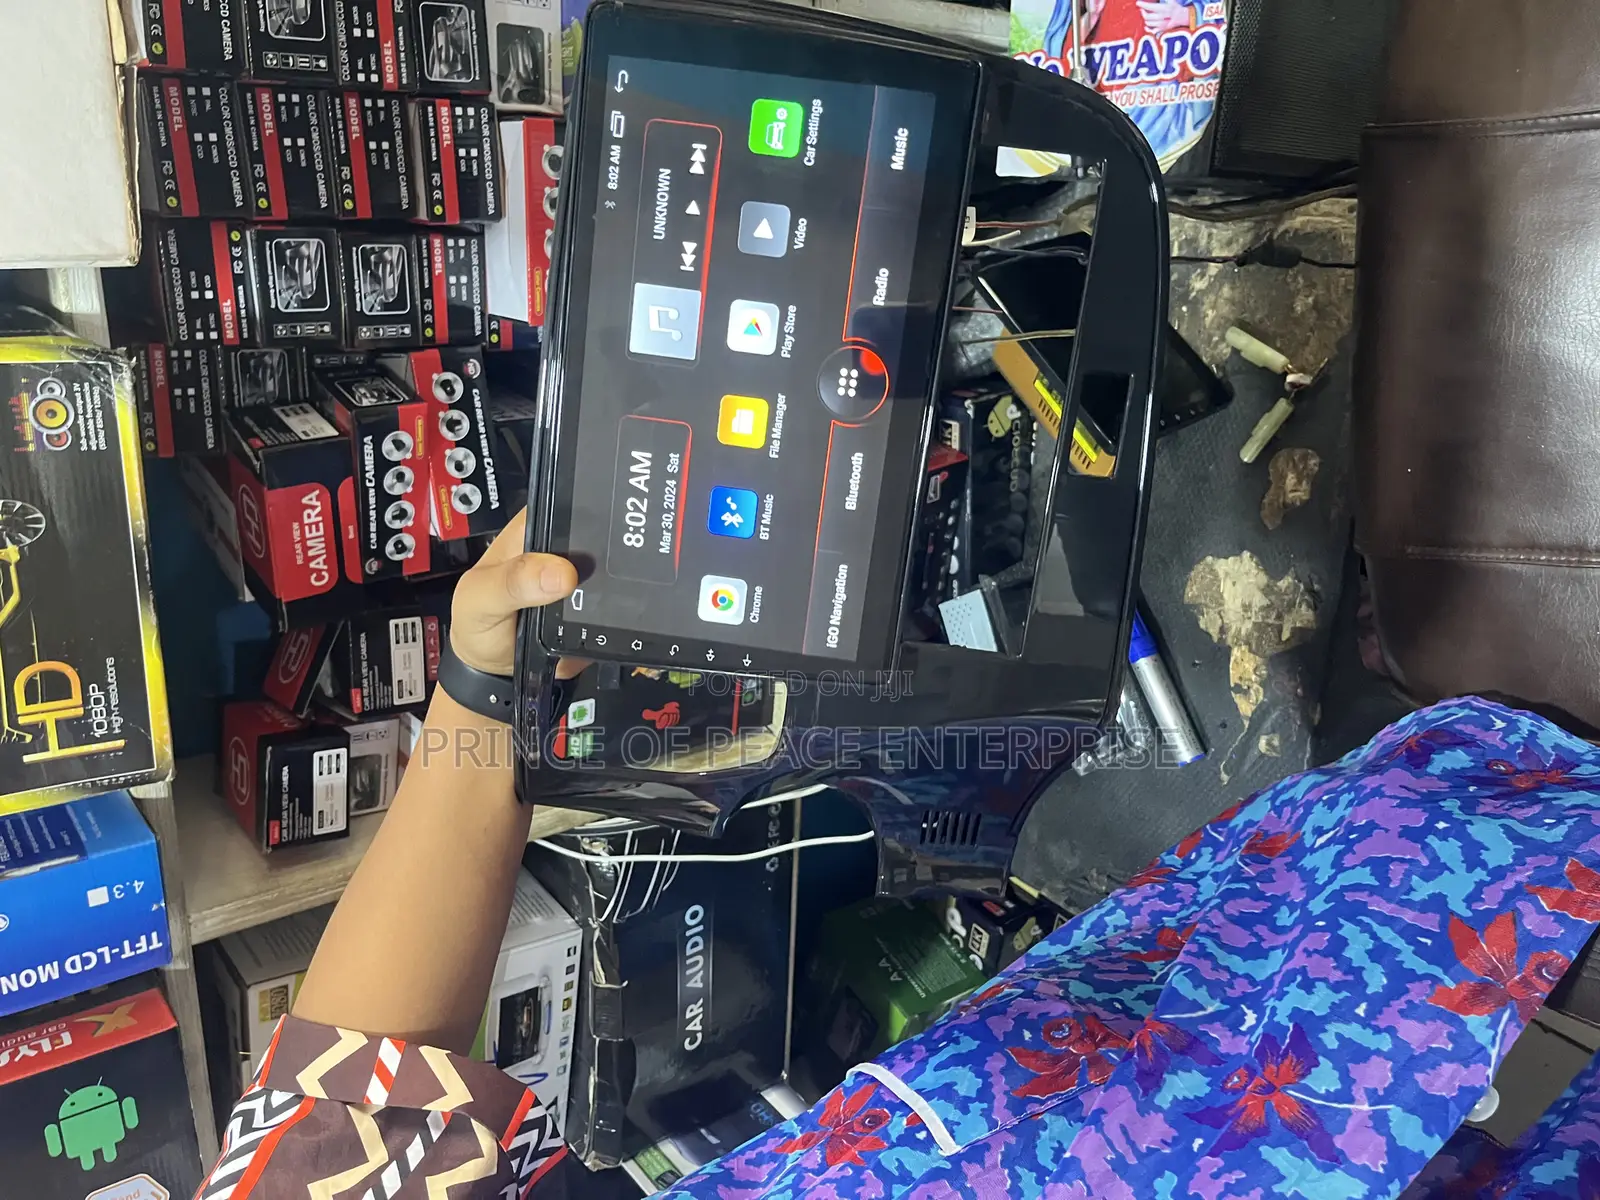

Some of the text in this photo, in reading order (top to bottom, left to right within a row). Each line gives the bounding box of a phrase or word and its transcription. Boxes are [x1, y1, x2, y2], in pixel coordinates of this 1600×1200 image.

[221, 20, 233, 60] CAMERA
[400, 52, 405, 61] IN
[340, 50, 350, 80] COLOR
[384, 41, 394, 83] MODEL
[153, 86, 167, 147] MADE IN CHINA
[169, 87, 183, 131] MODEL
[246, 93, 255, 115] MADE
[261, 93, 274, 136] MODEL
[1115, 91, 1137, 106] YOU
[1140, 87, 1175, 105] SHALL
[250, 117, 256, 125] IN
[349, 98, 359, 139] MODEL
[430, 128, 435, 136] IN
[441, 107, 451, 147] MODEL
[803, 99, 823, 166] Car Settings
[219, 88, 243, 207] COLOR CMOS/CCD CAMERA
[307, 95, 328, 208] COLOR CMOS/CCD CAMERA
[338, 131, 346, 154] CHINA
[391, 100, 408, 209] COLOR CMOS/CCD CAMERA
[480, 108, 495, 215] COLOR CMOS/CCD CAMERA
[890, 127, 908, 170] Music
[607, 144, 621, 190] 8:02 AM
[652, 168, 672, 240] UNKNOWN
[471, 239, 479, 265] COLOR
[793, 218, 808, 249] Video
[433, 239, 442, 275] MODEL
[168, 229, 188, 340] COLOR CMOS/CCD CAMERA
[472, 266, 480, 304] CMOS/CCD
[872, 268, 890, 306] Radio
[222, 299, 234, 338] MODEL
[240, 309, 246, 317] IN
[780, 305, 797, 358] Play Store
[154, 350, 165, 387] MODEL
[75, 392, 84, 414] output
[83, 382, 93, 418] frequencies
[199, 350, 208, 375] COLOR
[205, 418, 214, 449] CAMERA
[77, 415, 88, 451] Sub-woofer
[769, 393, 787, 458] File Manager
[364, 435, 375, 486] CAMERA
[472, 389, 499, 509] CAR REAR VIEW CAMERA
[622, 450, 652, 548] 8:02 AM
[659, 452, 680, 553] Mar 30, 2024 Sat
[845, 452, 864, 511] Bluetooth
[302, 489, 329, 586] CAMERA
[760, 493, 774, 540] BT Music
[293, 522, 303, 564] REAR VIEW
[749, 585, 764, 623] Chrome
[826, 564, 848, 648] iGO Navigation
[13, 660, 126, 763] HD
[89, 683, 108, 737] 1080P
[106, 657, 123, 733] High-resolutions
[570, 736, 580, 756] HD
[113, 879, 145, 899] 4.3
[64, 931, 163, 974] TFT-LCD
[683, 904, 705, 1050] CAR AUDIO
[40, 1023, 68, 1035] car
